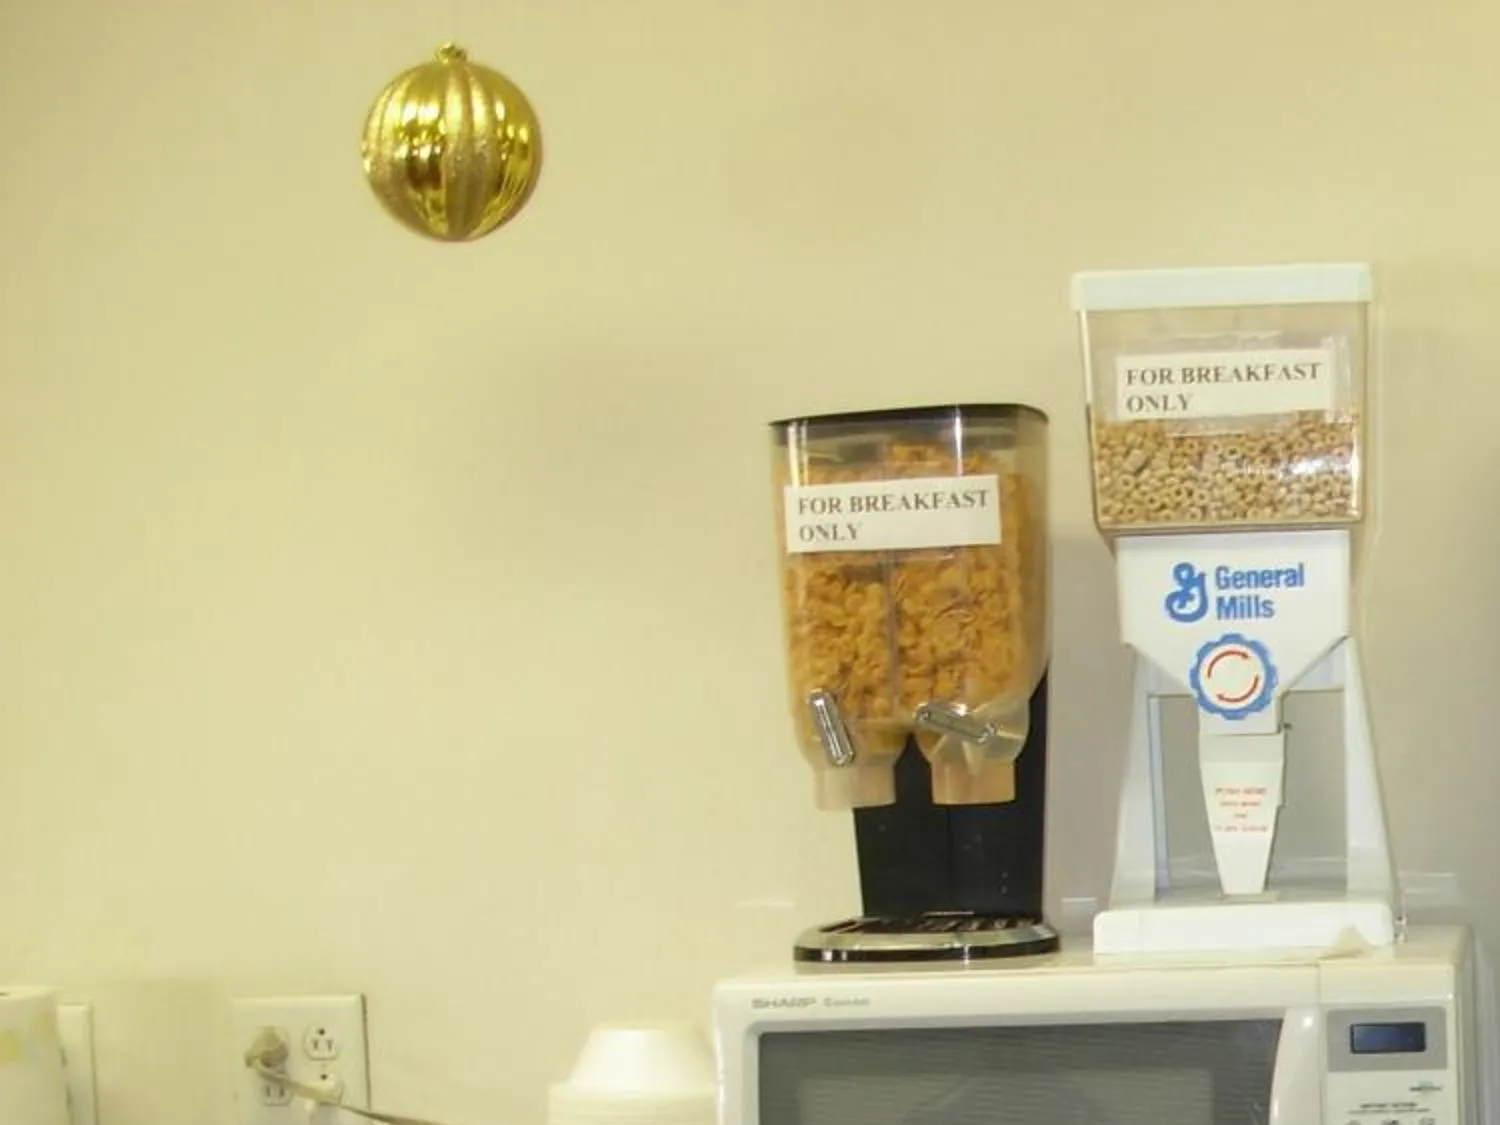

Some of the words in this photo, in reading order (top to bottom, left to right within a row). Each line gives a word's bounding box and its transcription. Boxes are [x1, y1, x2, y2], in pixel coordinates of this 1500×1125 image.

[1126, 367, 1174, 386] FOR
[1180, 362, 1322, 384] BREAKFAST
[1126, 394, 1193, 413] ONLY
[799, 496, 843, 515] FOR
[850, 490, 990, 513] BREAKFAST
[799, 522, 862, 542] ONLY
[1215, 562, 1305, 590] General
[1216, 595, 1275, 620] Mills
[752, 996, 817, 1009] SHARP
